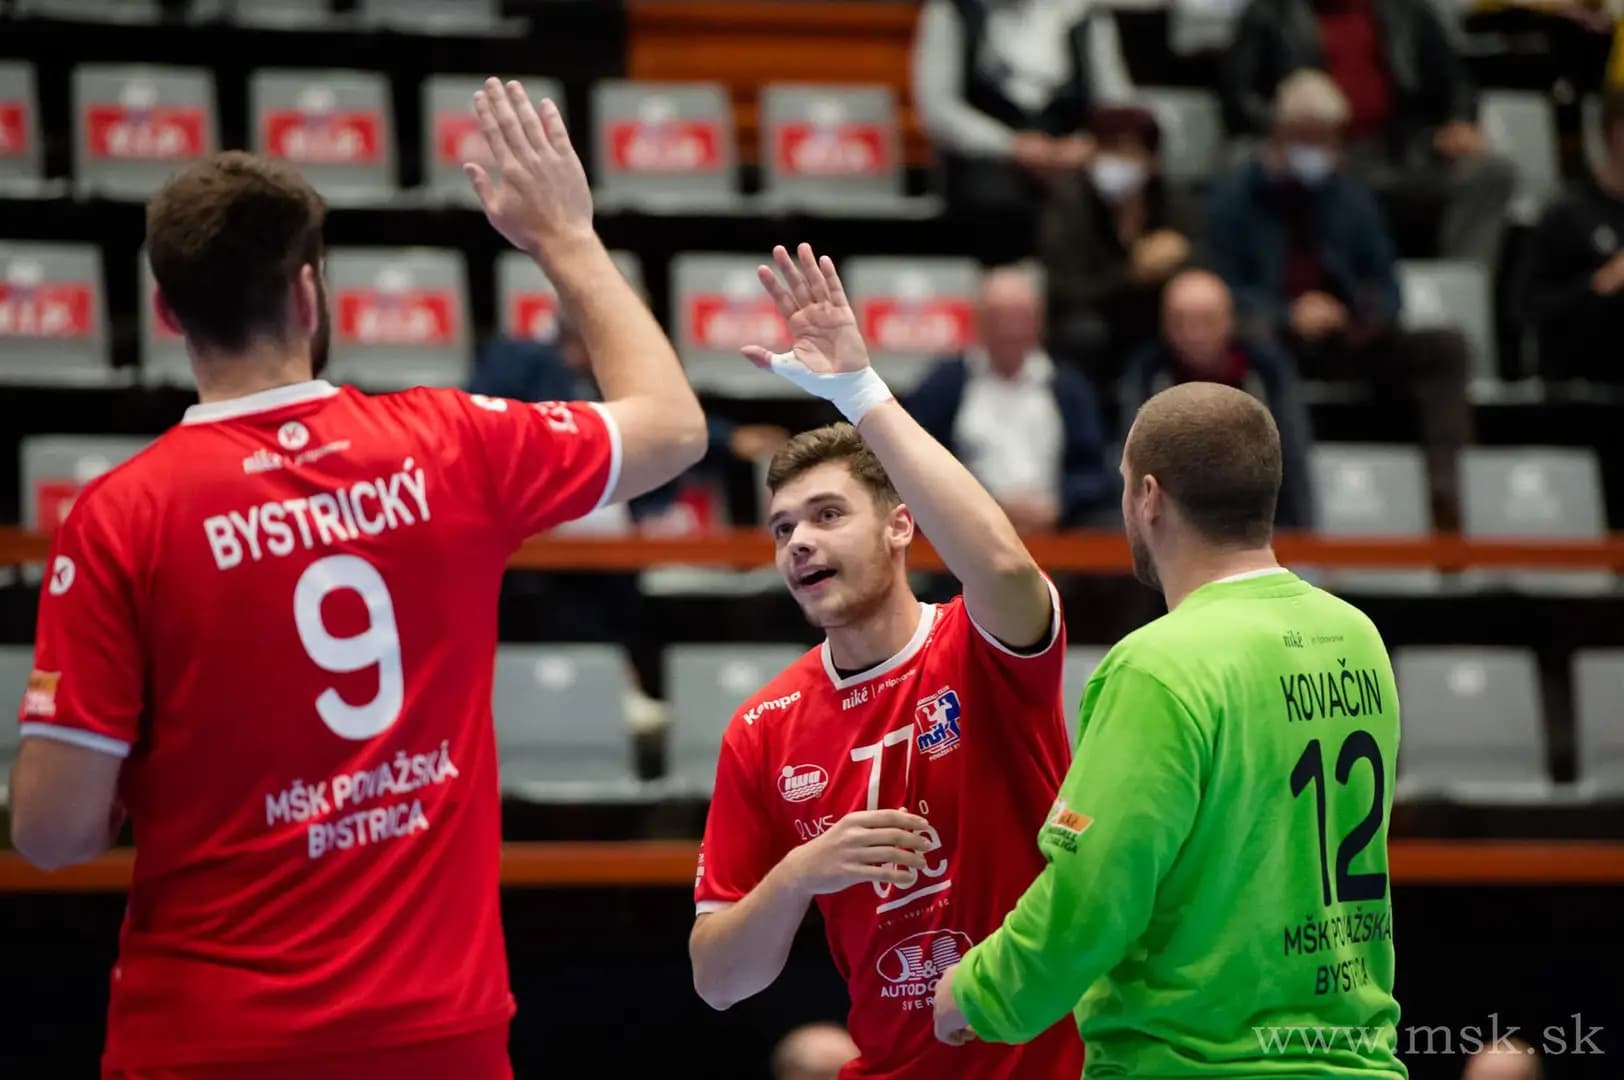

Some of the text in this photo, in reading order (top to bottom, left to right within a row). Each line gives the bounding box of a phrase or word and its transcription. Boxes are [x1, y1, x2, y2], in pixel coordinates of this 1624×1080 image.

[203, 456, 430, 570] BYSTRICKÝ
[293, 554, 404, 741] 9
[744, 691, 801, 725] Kempa
[842, 687, 869, 711] niké
[1280, 657, 1382, 722] KOVAČIN
[265, 739, 459, 846] MŠK POVAŽSKÁ
[1290, 730, 1388, 907] 12
[307, 799, 430, 860] BYSTRICA
[1284, 916, 1331, 956] MŠK
[1315, 957, 1369, 995] BYSTA
